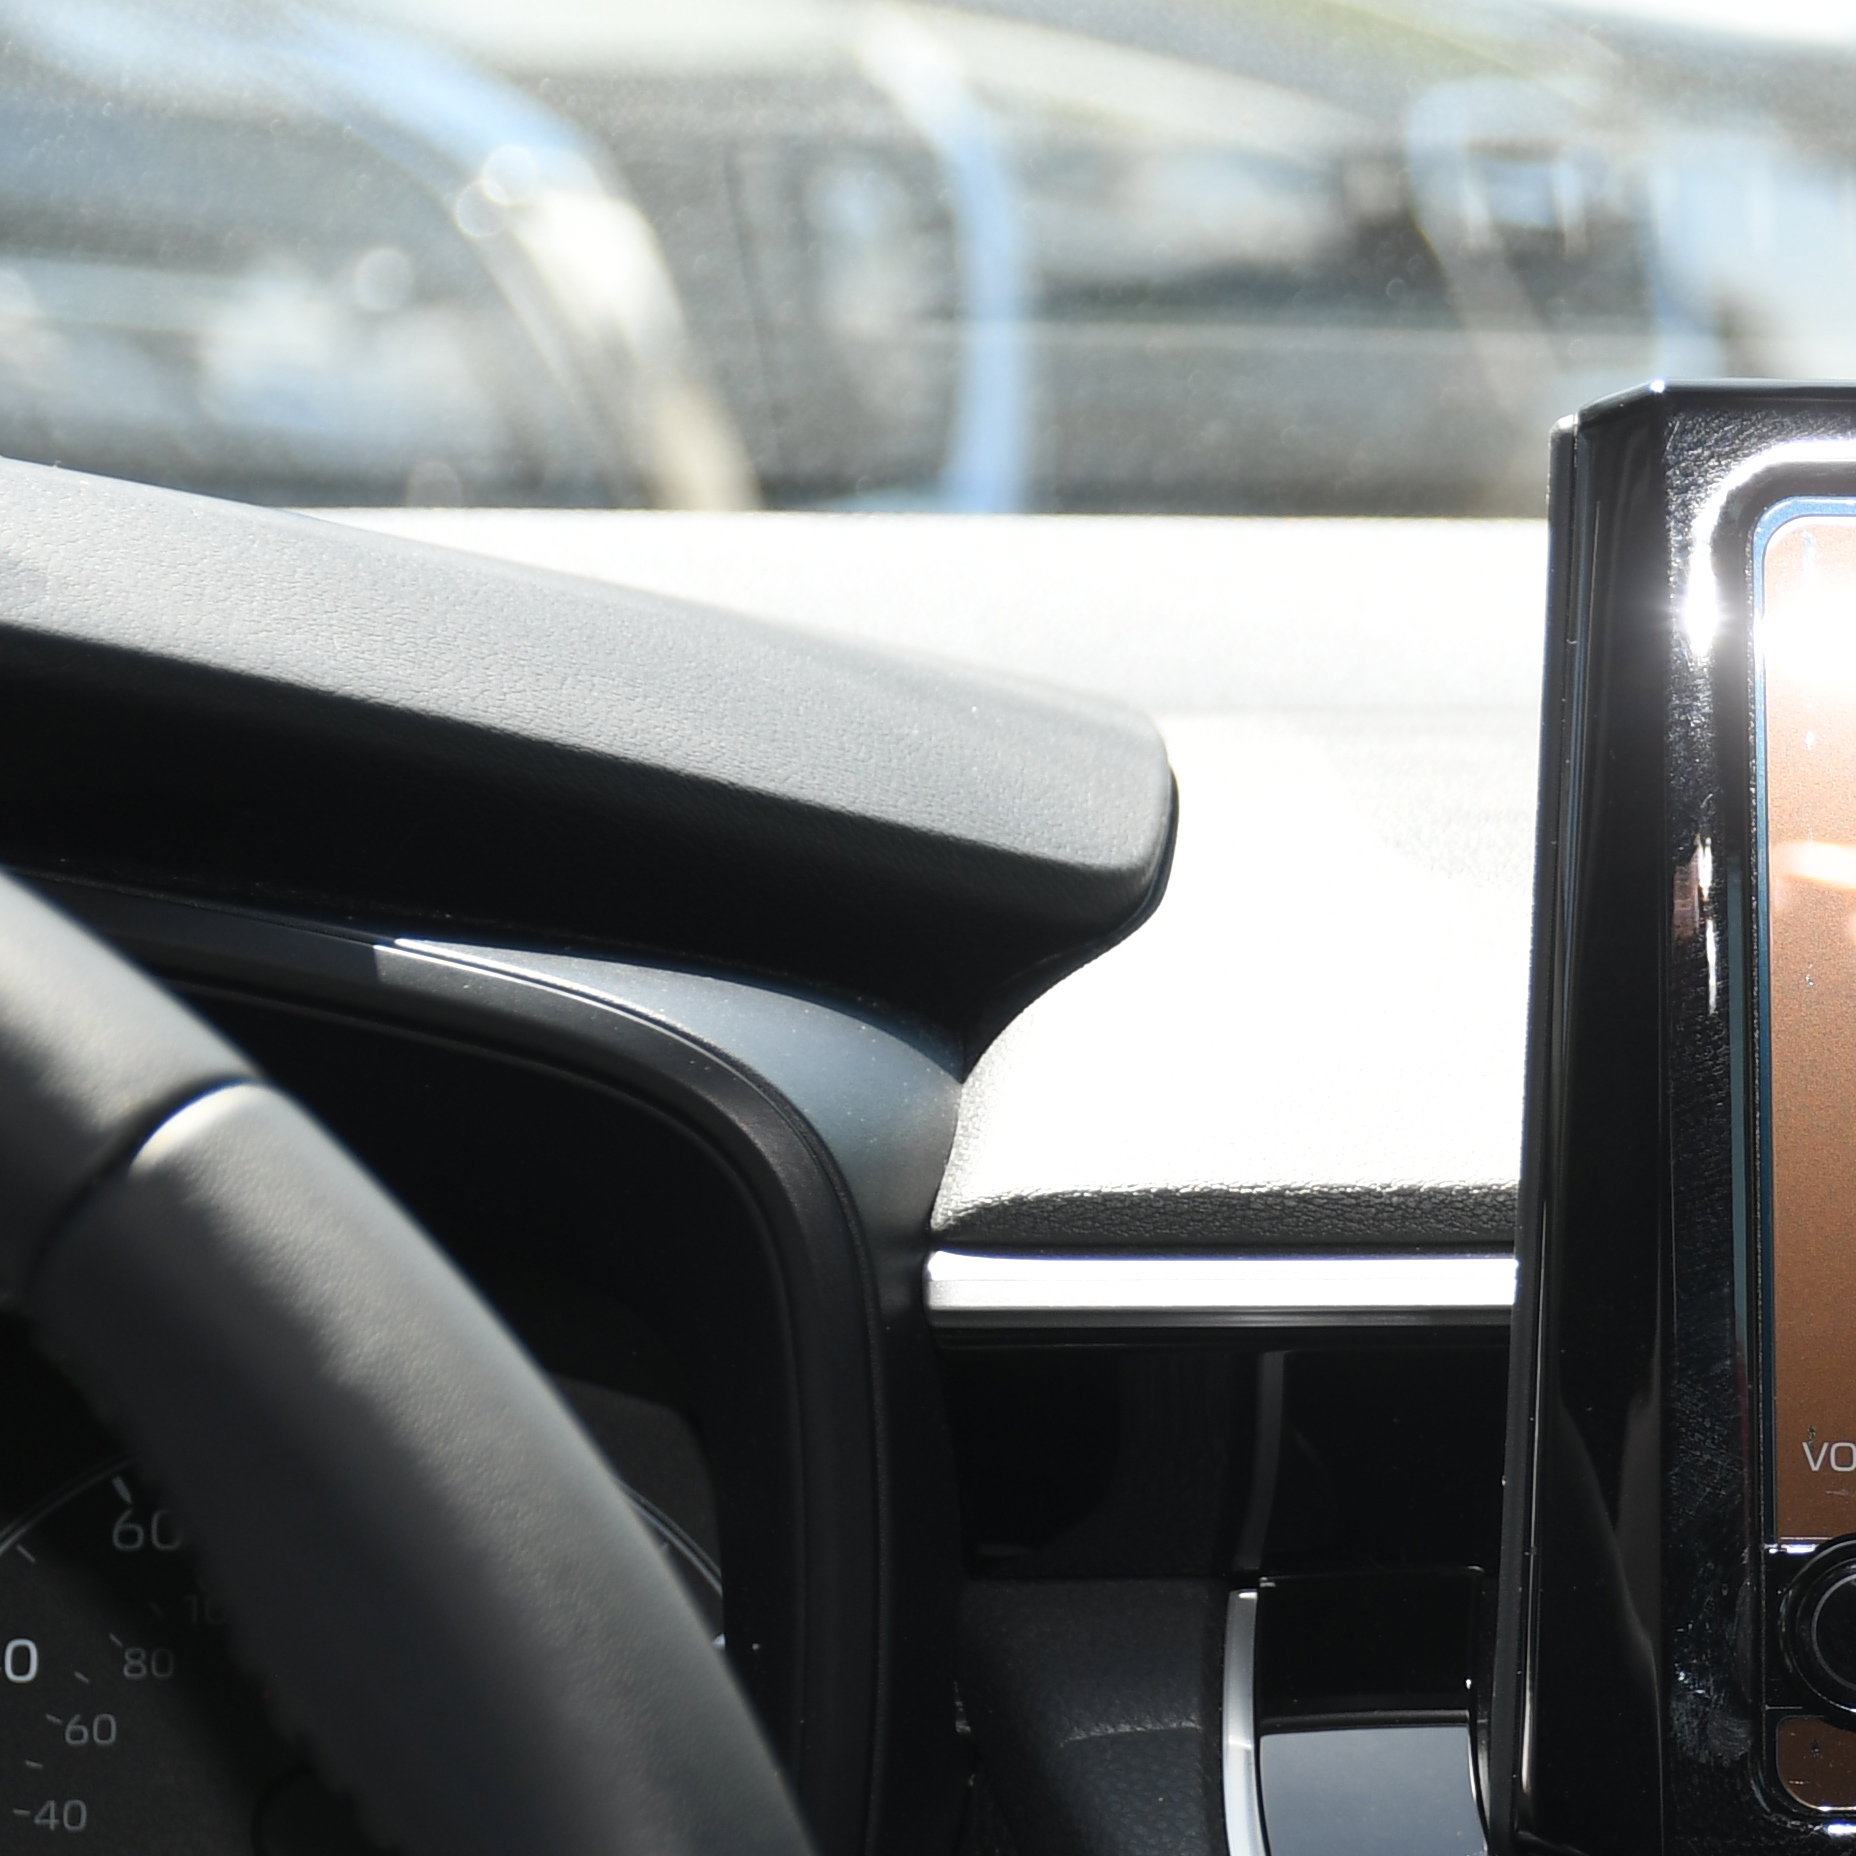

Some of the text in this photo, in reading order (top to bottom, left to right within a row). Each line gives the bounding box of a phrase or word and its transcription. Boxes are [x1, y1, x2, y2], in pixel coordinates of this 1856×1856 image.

[111, 1507, 183, 1551] 60
[0, 1636, 39, 1683] 0
[123, 1646, 175, 1679] 80
[64, 1712, 117, 1747] 60
[33, 1800, 88, 1832] 40
